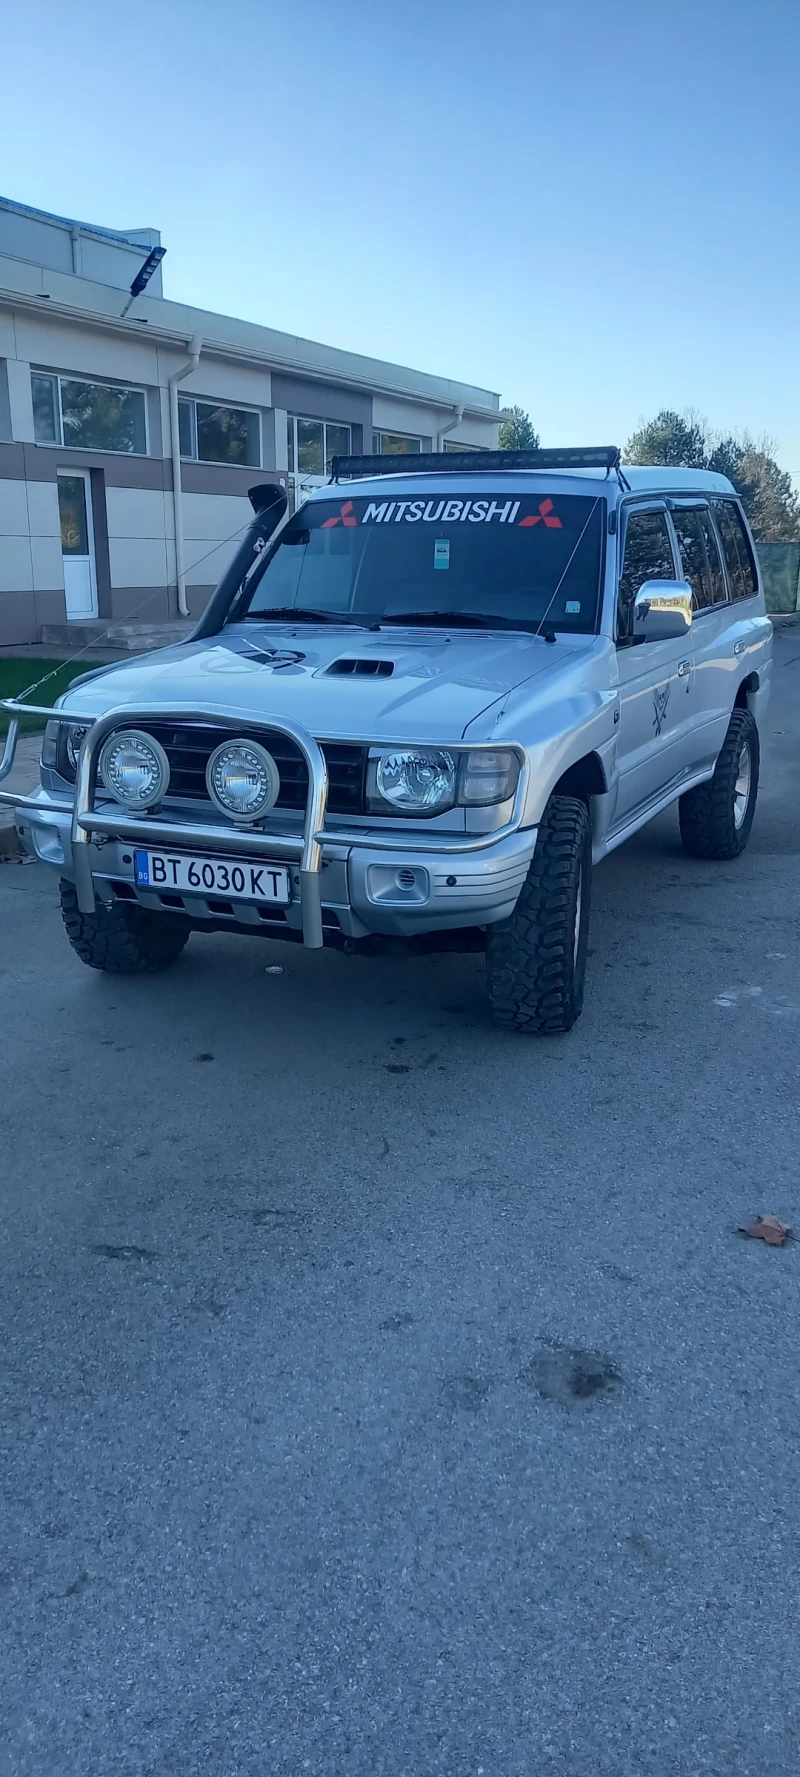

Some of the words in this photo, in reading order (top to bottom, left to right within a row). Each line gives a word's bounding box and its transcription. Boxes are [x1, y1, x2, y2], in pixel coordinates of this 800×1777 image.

[362, 500, 520, 523] MITSUBISHI
[138, 871, 148, 880] BG
[151, 857, 181, 884] BT
[187, 862, 245, 892] 6030
[250, 869, 282, 897] KT
